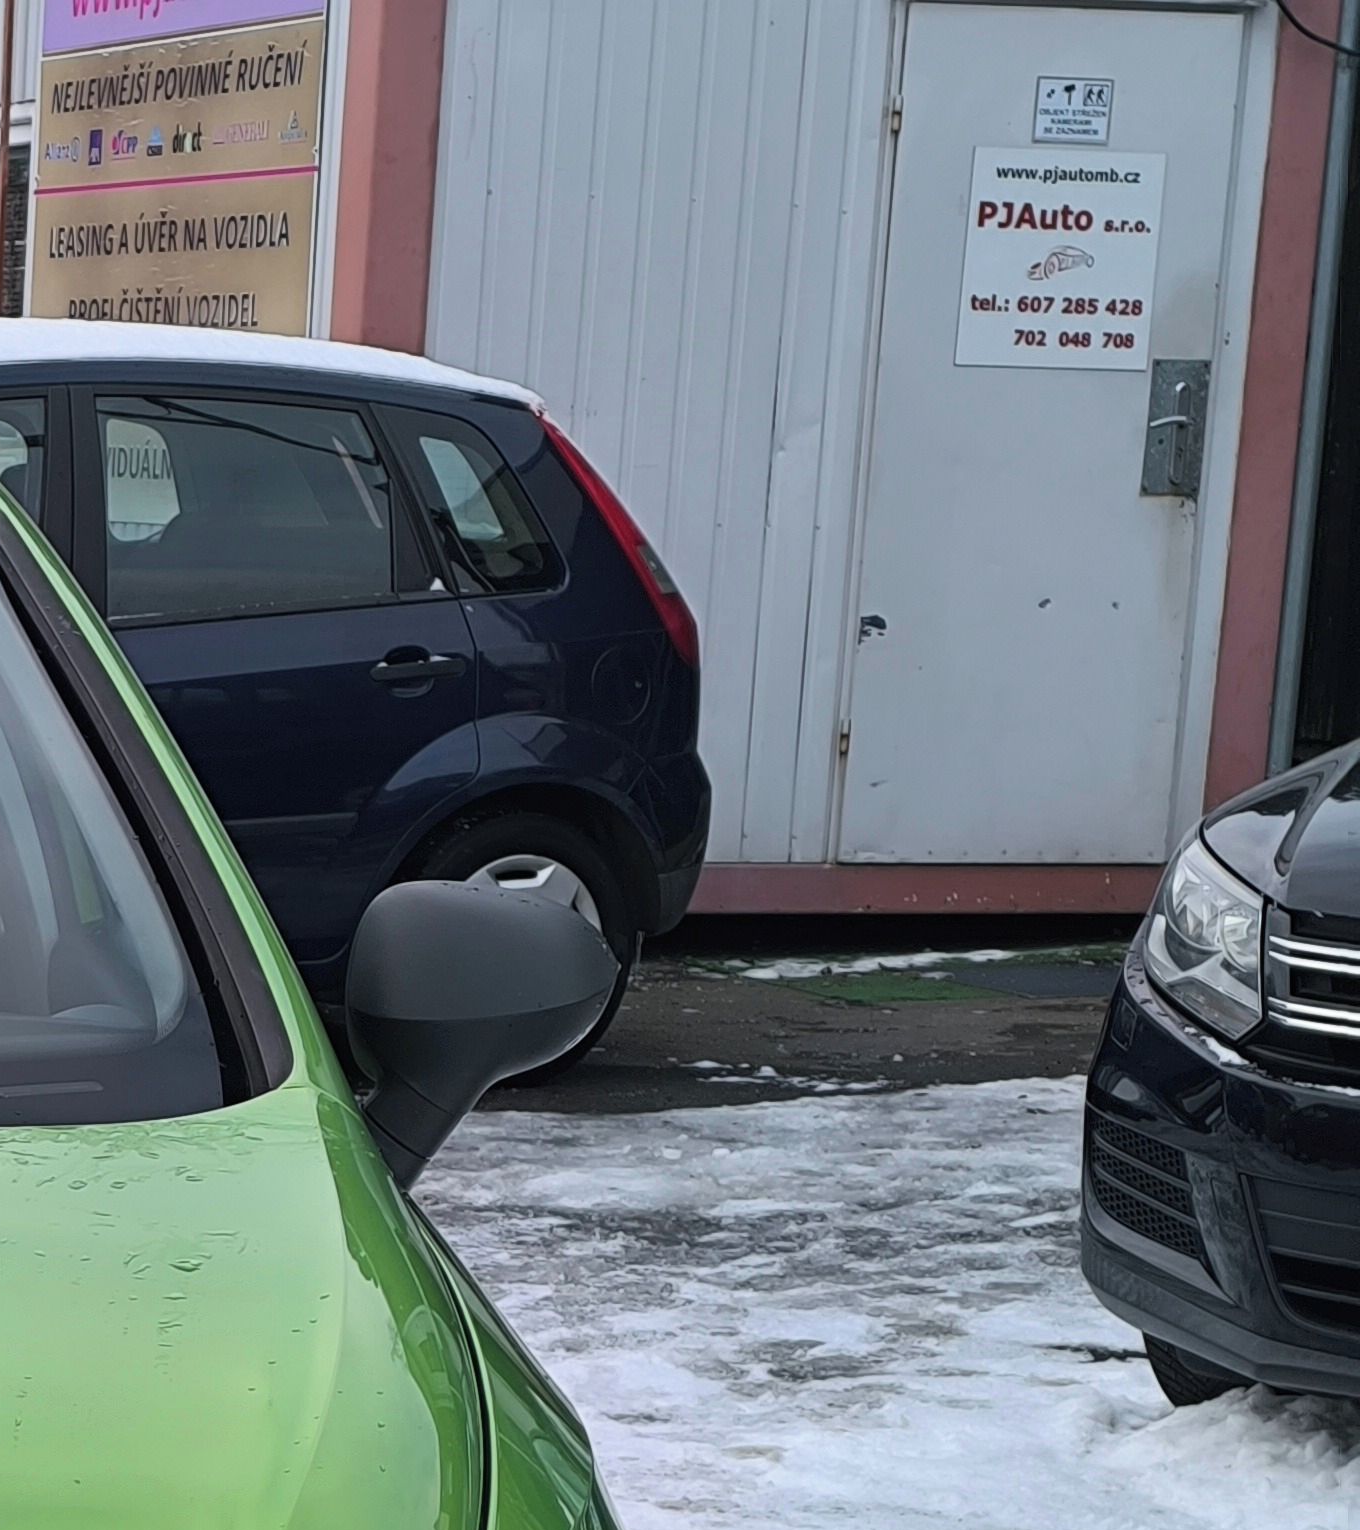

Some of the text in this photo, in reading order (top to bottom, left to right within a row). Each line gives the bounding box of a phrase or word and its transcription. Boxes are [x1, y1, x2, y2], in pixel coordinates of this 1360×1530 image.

[51, 40, 307, 114] NEJLEVNĚJŠÍ POVINNÉ RUČENÍ
[996, 166, 1141, 184] www.pjautomb.cz
[978, 201, 1151, 233] PJAuto s.r.o.
[49, 211, 290, 258] LEASING A ÚVĚR NA VOZIDLA
[187, 293, 258, 327] VOZIDEL
[970, 294, 1143, 316] tel.: 607 285 428
[1013, 329, 1135, 349] 702 048 708
